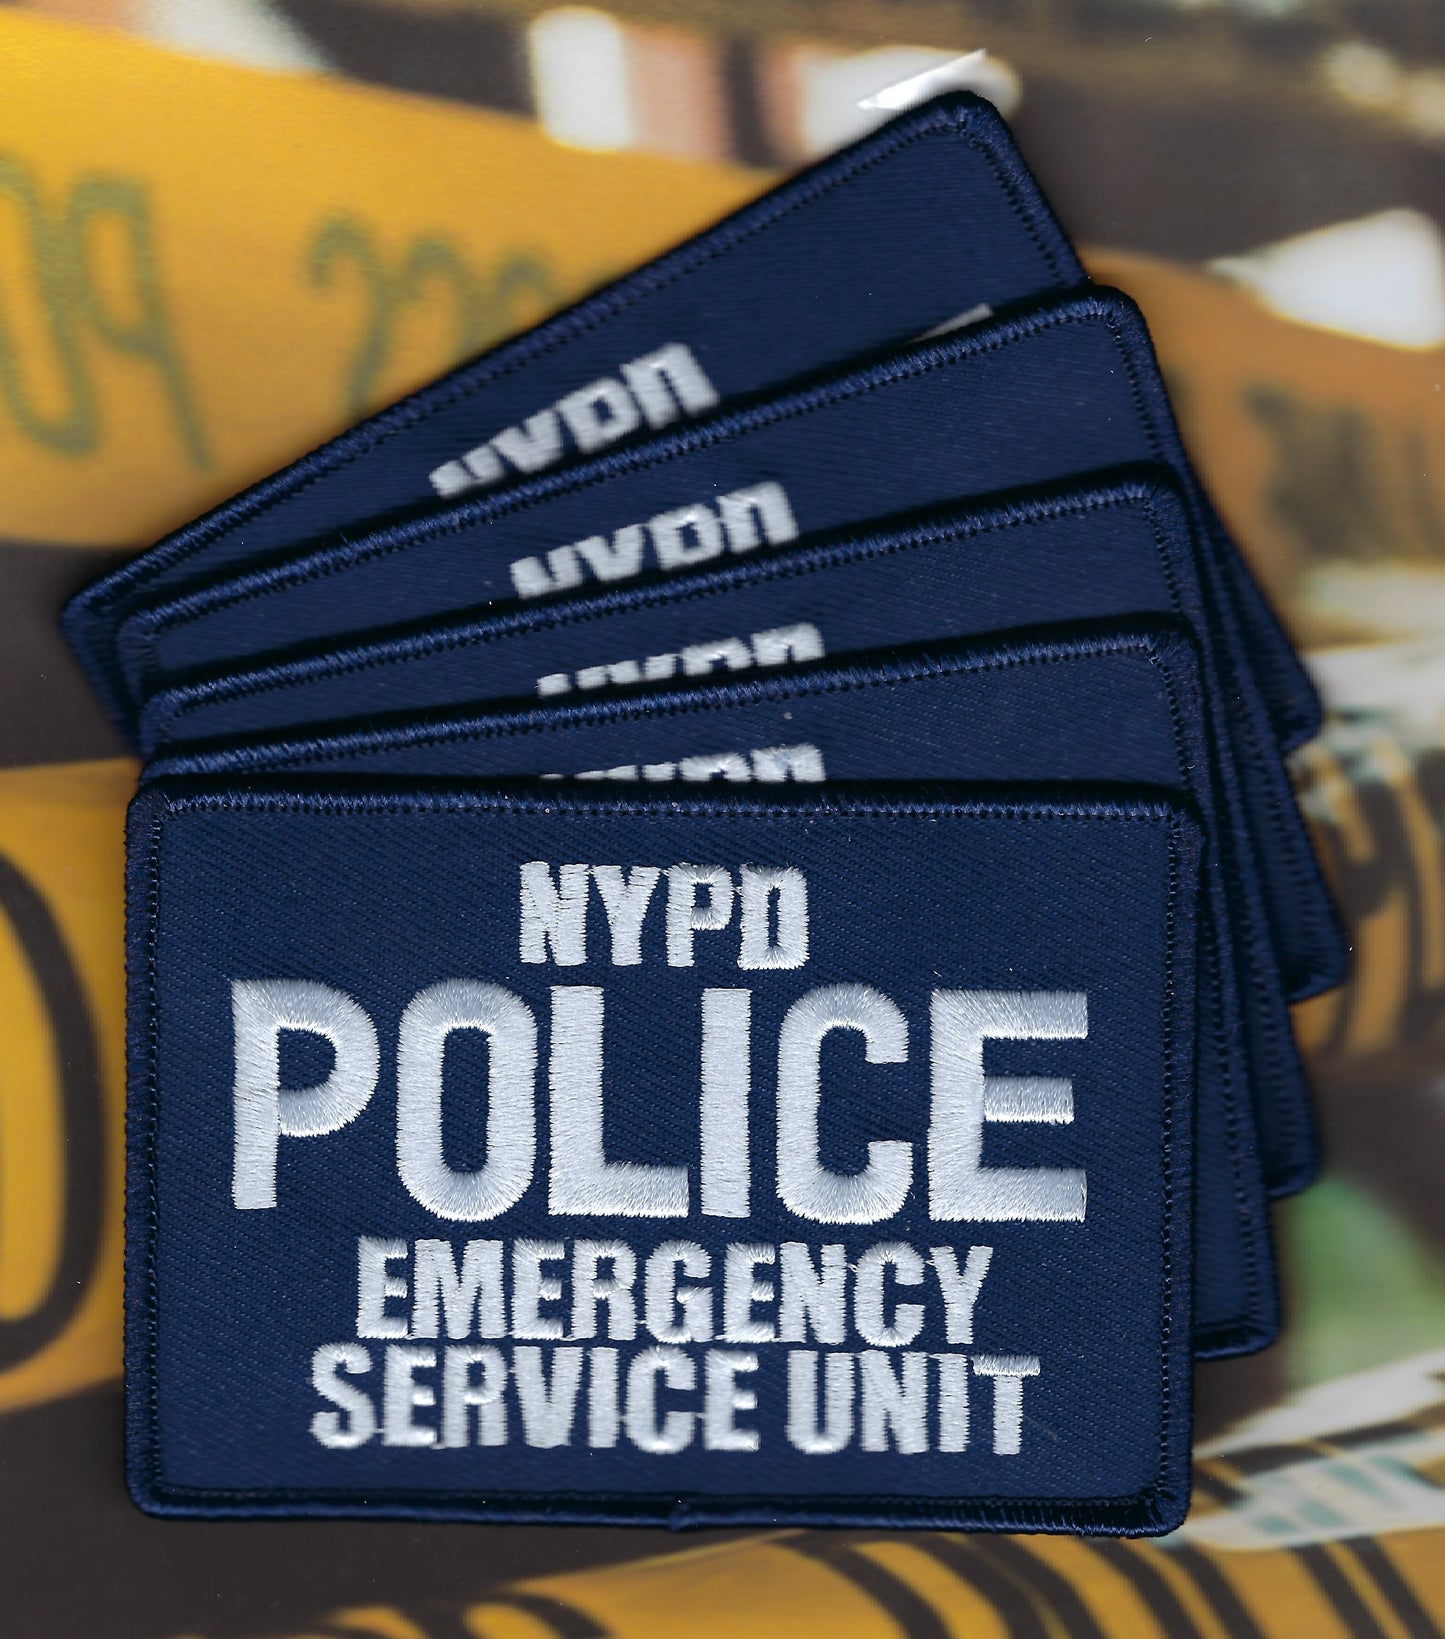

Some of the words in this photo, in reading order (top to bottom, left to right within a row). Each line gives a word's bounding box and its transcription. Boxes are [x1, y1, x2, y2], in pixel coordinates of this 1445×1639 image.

[519, 861, 810, 971] NYPD
[230, 980, 1090, 1225] POLICE
[355, 1236, 994, 1347] EMERGENCY
[310, 1342, 760, 1455] SERVICE
[785, 1349, 1041, 1456] UNIT
